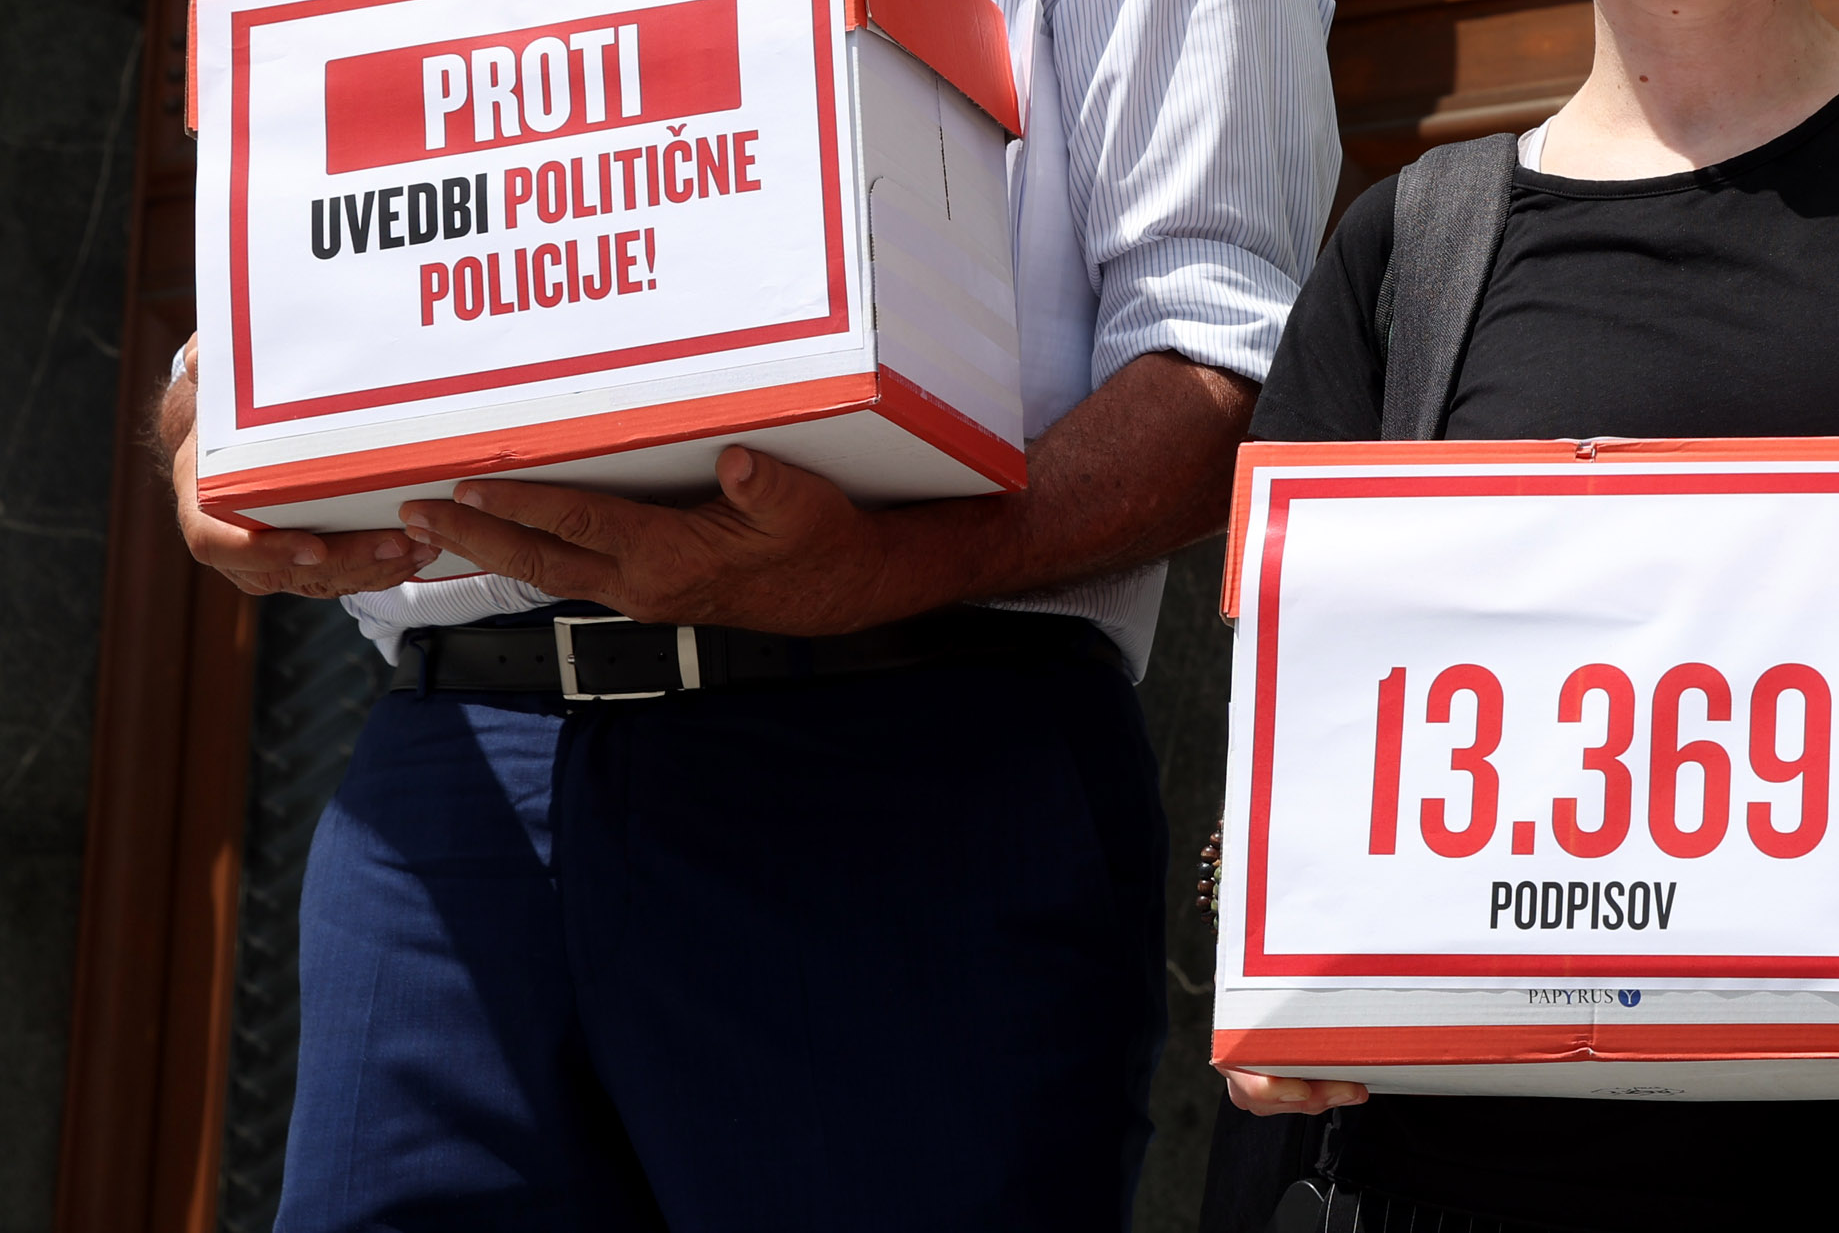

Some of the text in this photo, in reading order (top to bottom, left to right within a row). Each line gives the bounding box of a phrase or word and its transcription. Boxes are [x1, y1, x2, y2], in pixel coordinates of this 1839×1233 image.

[421, 22, 644, 152] PROTI
[311, 123, 762, 260] UVEDBI POLITIČNE
[420, 228, 657, 327] POLICIJE!
[1367, 662, 1833, 860] 13.369
[1489, 880, 1677, 931] PODPISOV
[1528, 988, 1614, 1005] PAPYRUS
